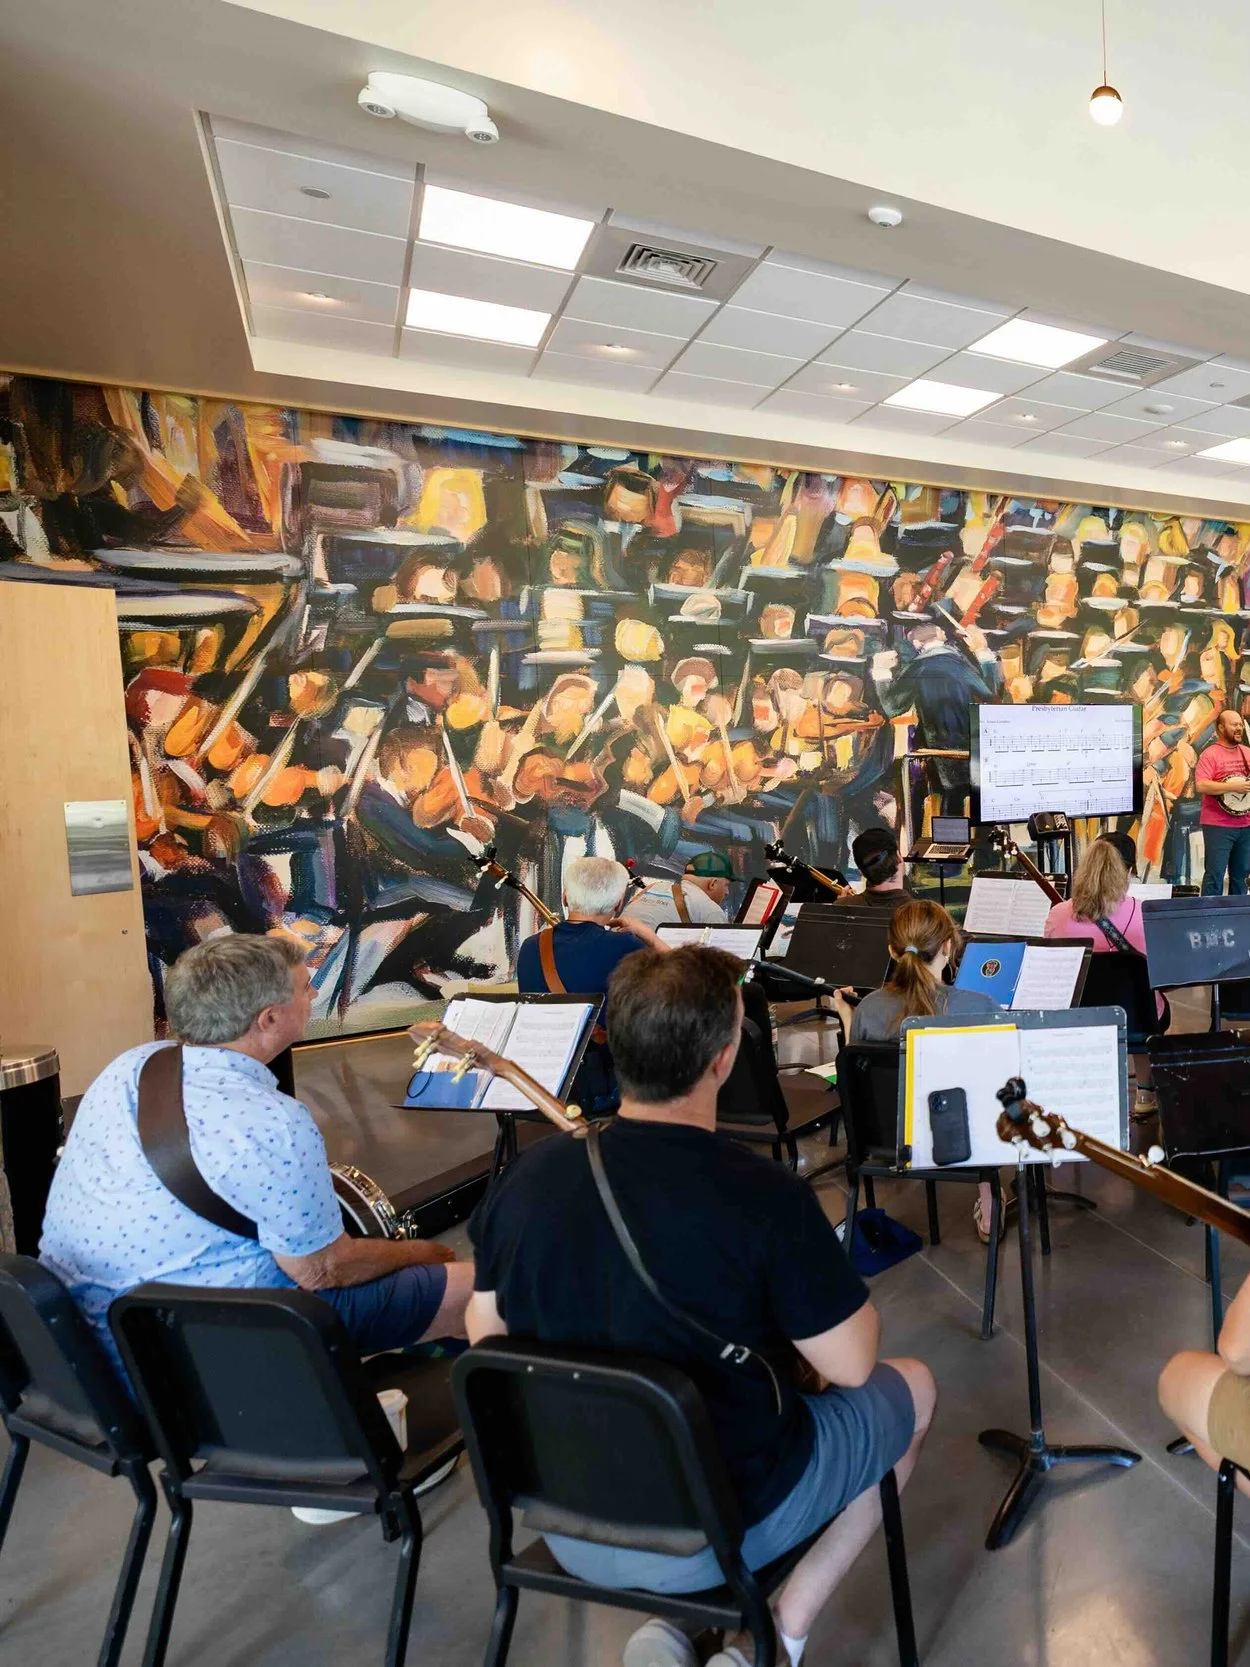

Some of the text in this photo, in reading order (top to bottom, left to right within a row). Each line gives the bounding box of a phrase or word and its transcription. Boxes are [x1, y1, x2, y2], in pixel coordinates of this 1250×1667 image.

[1031, 704, 1087, 713] Presbyterian Guitar
[1187, 928, 1235, 950] BMC
